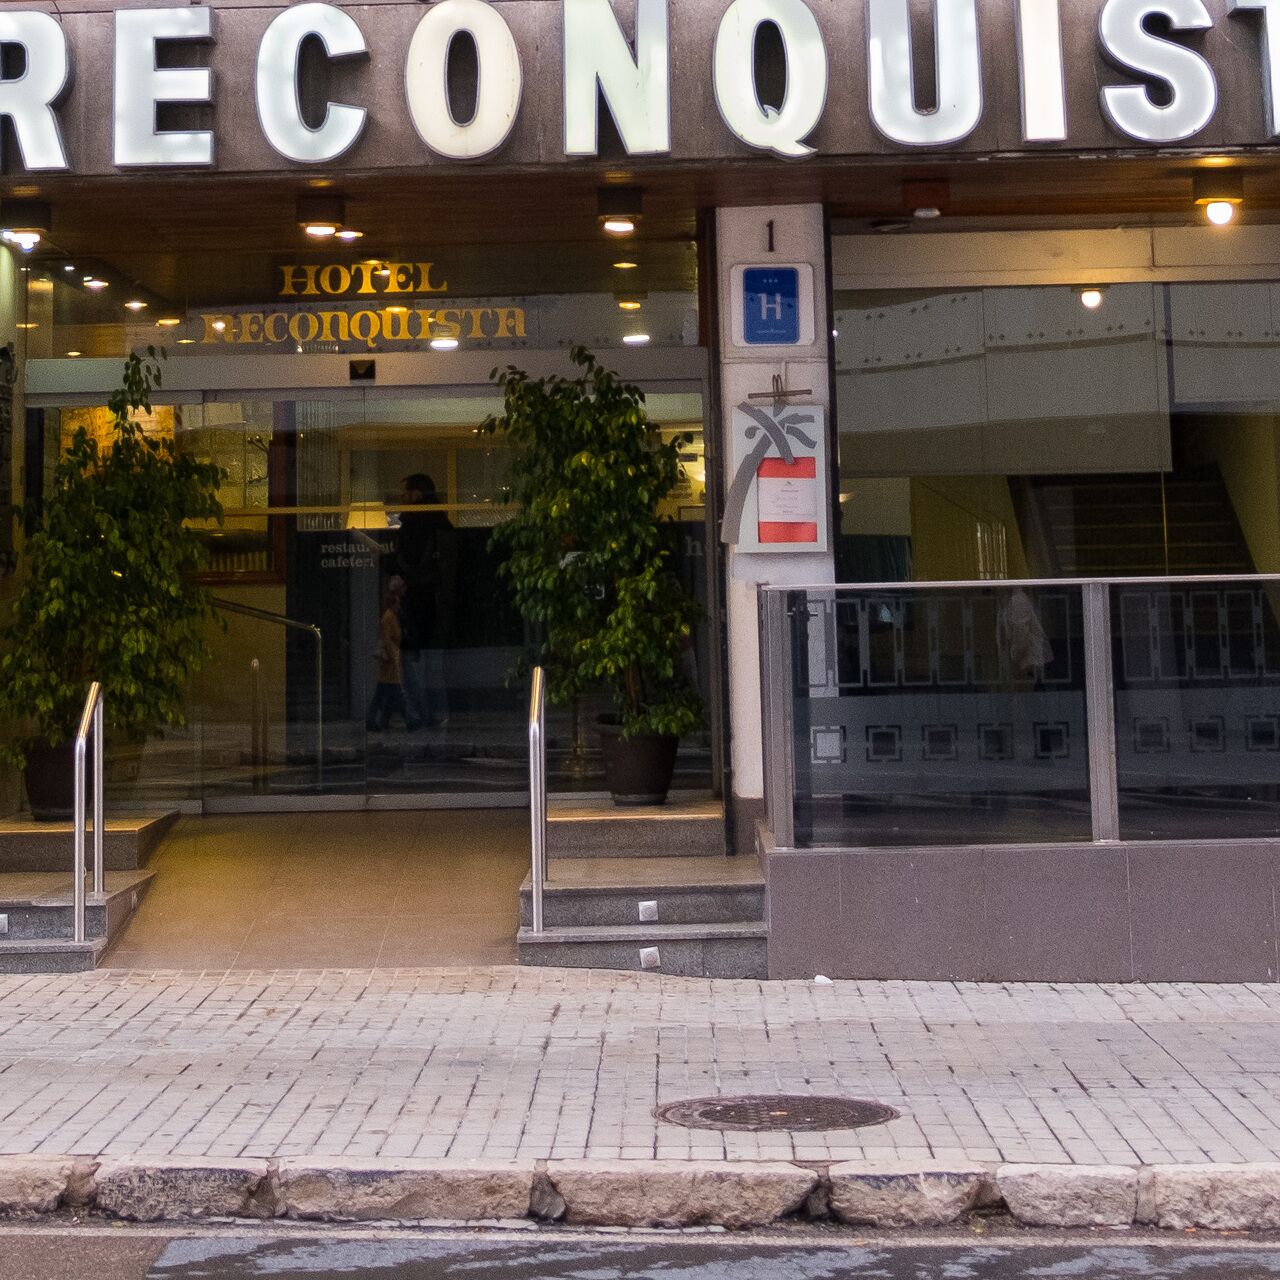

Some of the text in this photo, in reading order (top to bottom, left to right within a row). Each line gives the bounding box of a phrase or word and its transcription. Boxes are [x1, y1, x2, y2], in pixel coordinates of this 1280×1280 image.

[279, 262, 447, 295] HOTEL
[758, 293, 782, 320] H
[200, 308, 527, 347] RECONQUISTA
